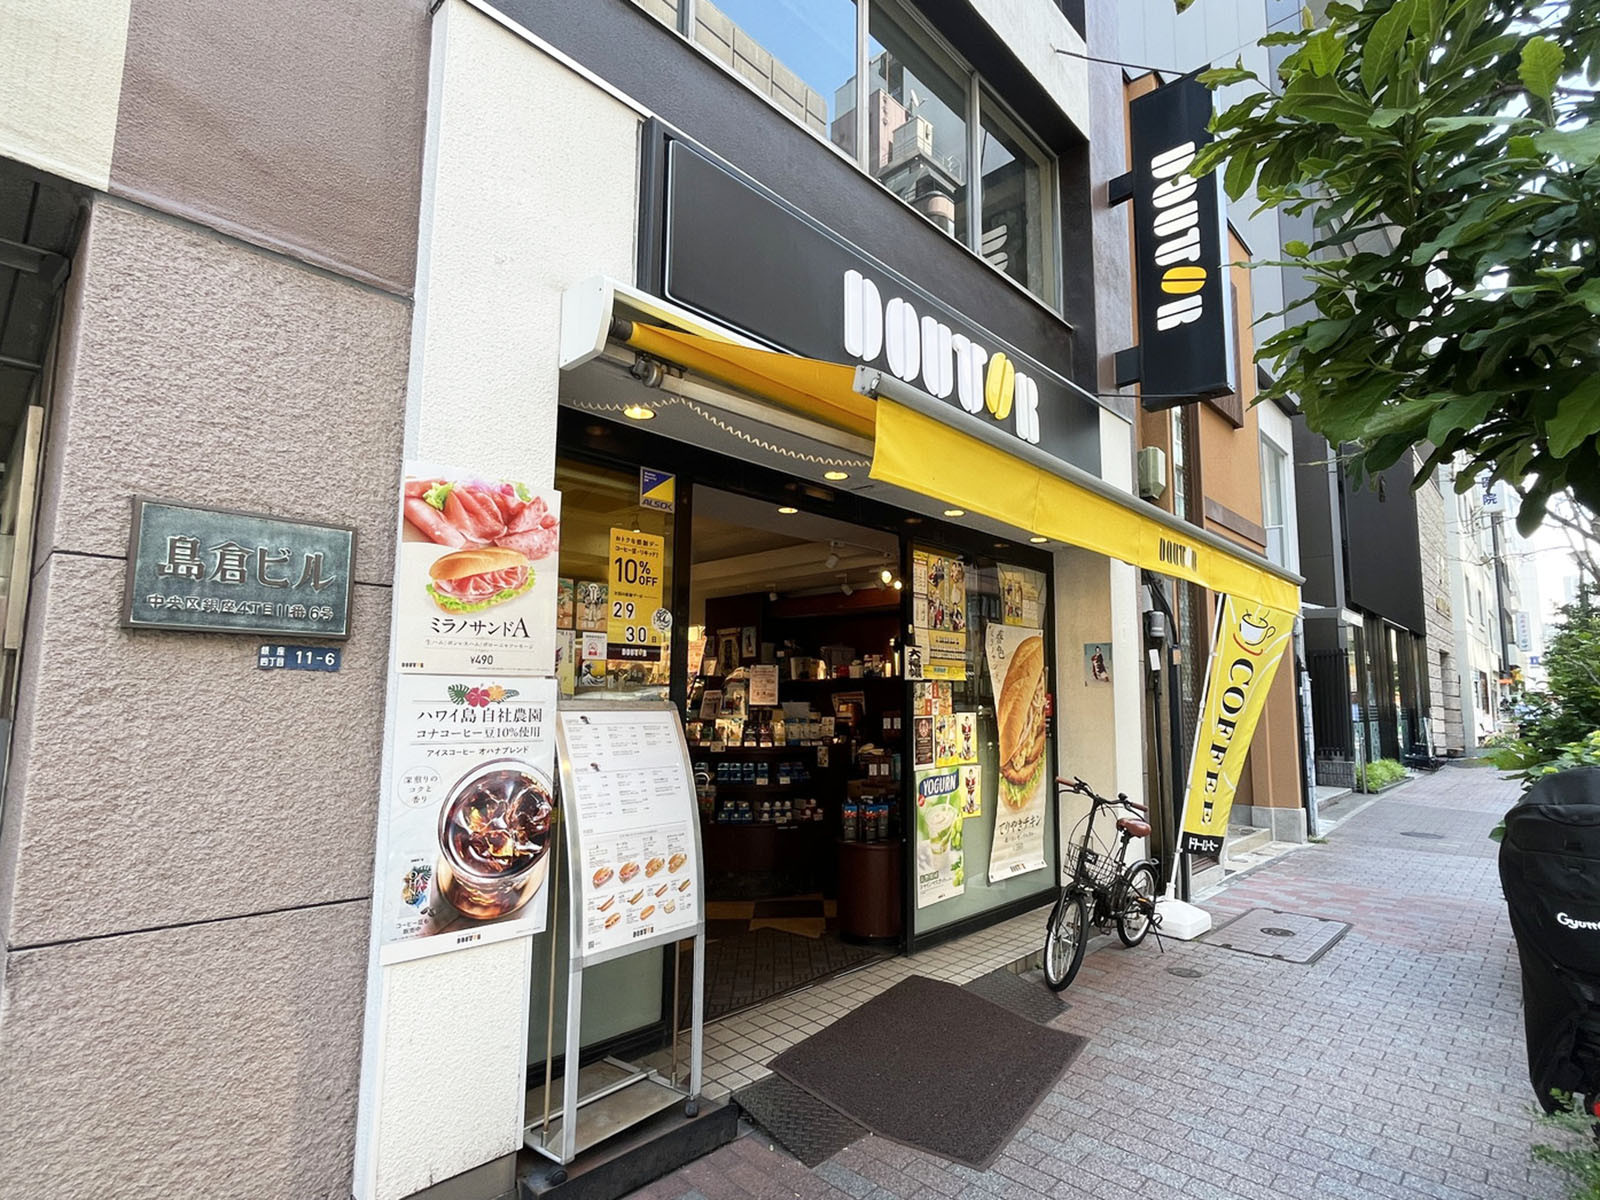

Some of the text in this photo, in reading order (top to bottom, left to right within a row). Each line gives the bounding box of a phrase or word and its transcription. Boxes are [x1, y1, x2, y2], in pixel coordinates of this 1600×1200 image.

[1150, 141, 1208, 332] DOUTOR
[844, 269, 1040, 444] DOUTOR
[642, 499, 673, 512] ALSOK
[1159, 537, 1197, 573] DOUTOR
[157, 535, 337, 593] 島倉ビル
[639, 576, 658, 587] OFF
[614, 601, 634, 618] 29
[431, 617, 530, 638] ミラノサンドA
[626, 626, 647, 643] 30
[295, 650, 336, 666] 11-6
[470, 655, 494, 665] ¥490
[417, 707, 543, 724] ハワイ島 自社農園
[1201, 657, 1255, 826] COFFEE
[426, 745, 530, 757] アイスコーヒー オハナブレンド
[923, 774, 957, 796] YOGURN
